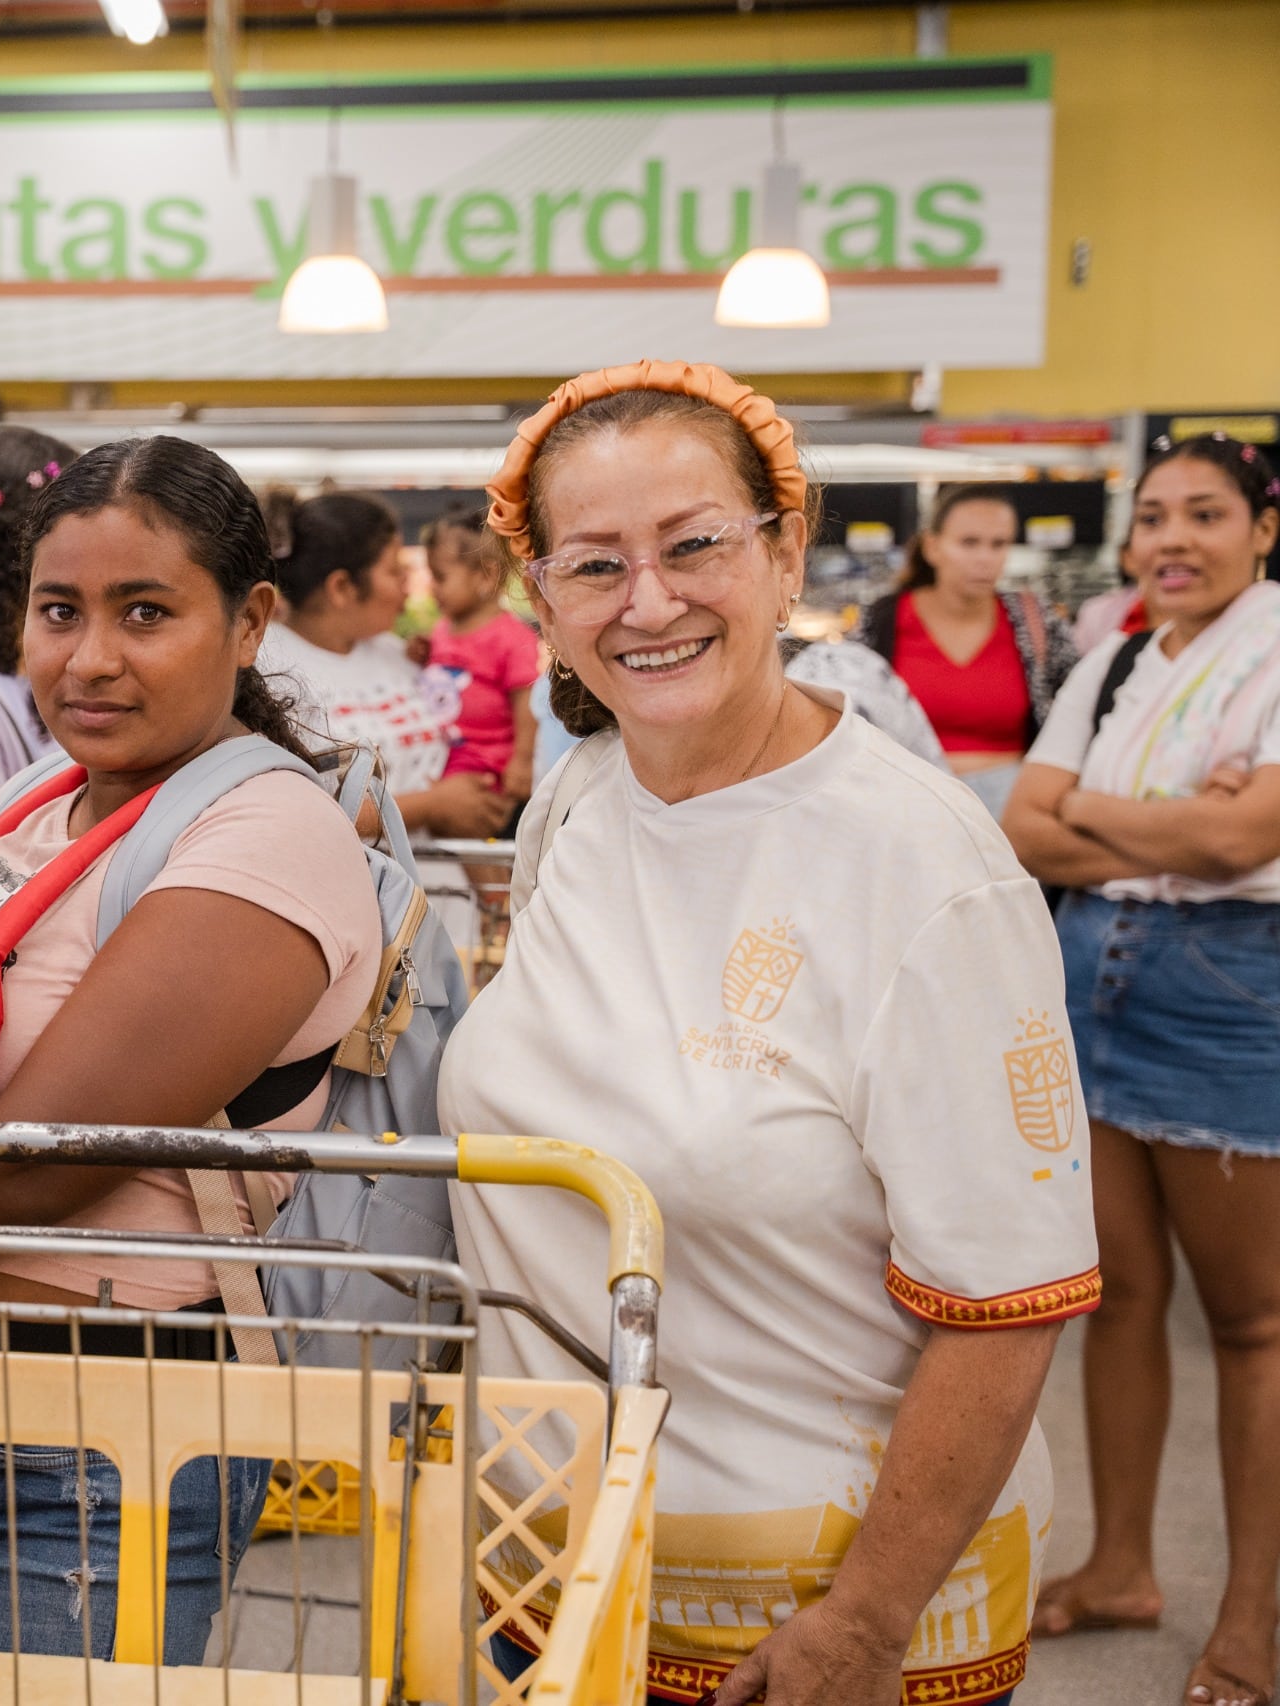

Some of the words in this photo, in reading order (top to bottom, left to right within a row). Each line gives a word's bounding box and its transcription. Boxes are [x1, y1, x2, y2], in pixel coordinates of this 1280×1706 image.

[251, 196, 312, 299] y
[367, 158, 984, 274] verduas
[677, 1039, 707, 1063] DE
[709, 1052, 781, 1081] LORICA
[736, 1036, 793, 1067] CRUZ
